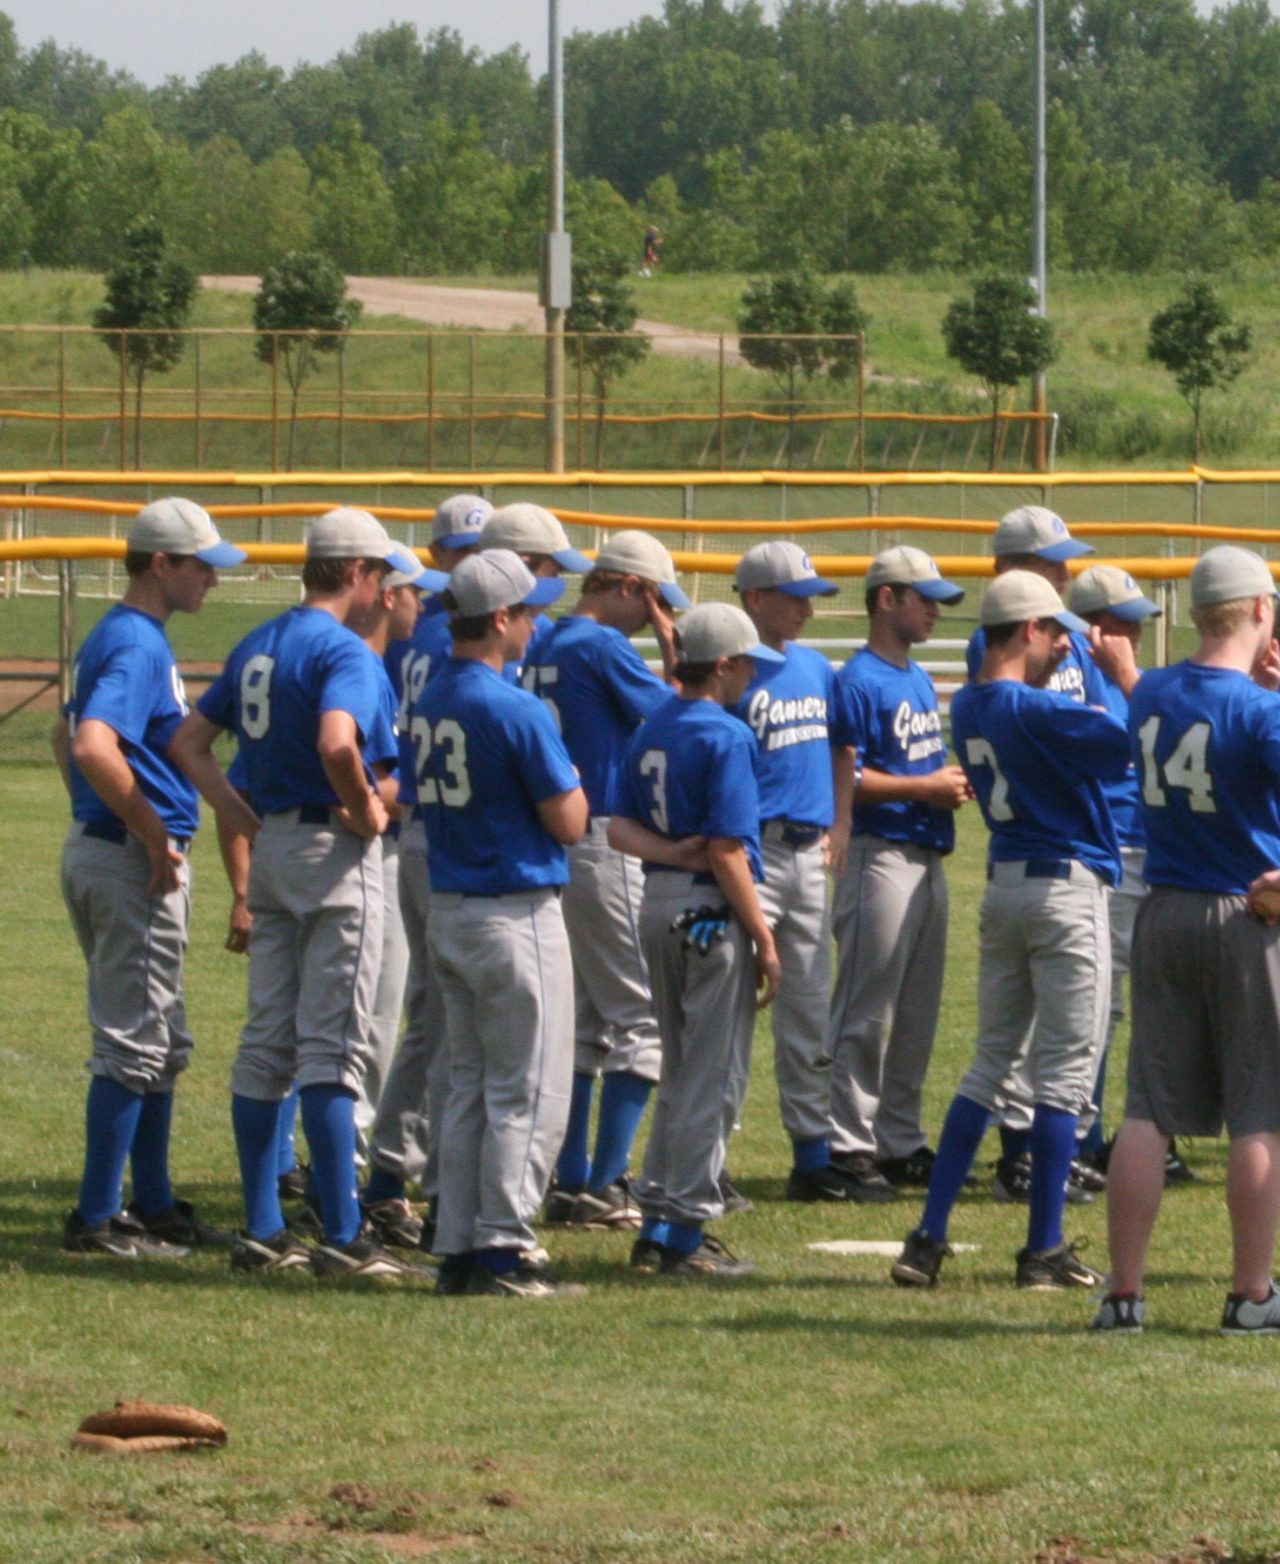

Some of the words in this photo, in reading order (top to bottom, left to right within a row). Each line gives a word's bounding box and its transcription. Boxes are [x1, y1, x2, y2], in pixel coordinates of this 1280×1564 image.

[241, 653, 275, 739] 8
[410, 716, 472, 807] 23
[639, 749, 670, 833] 3
[966, 737, 1015, 822] 7
[1138, 715, 1217, 813] 14
